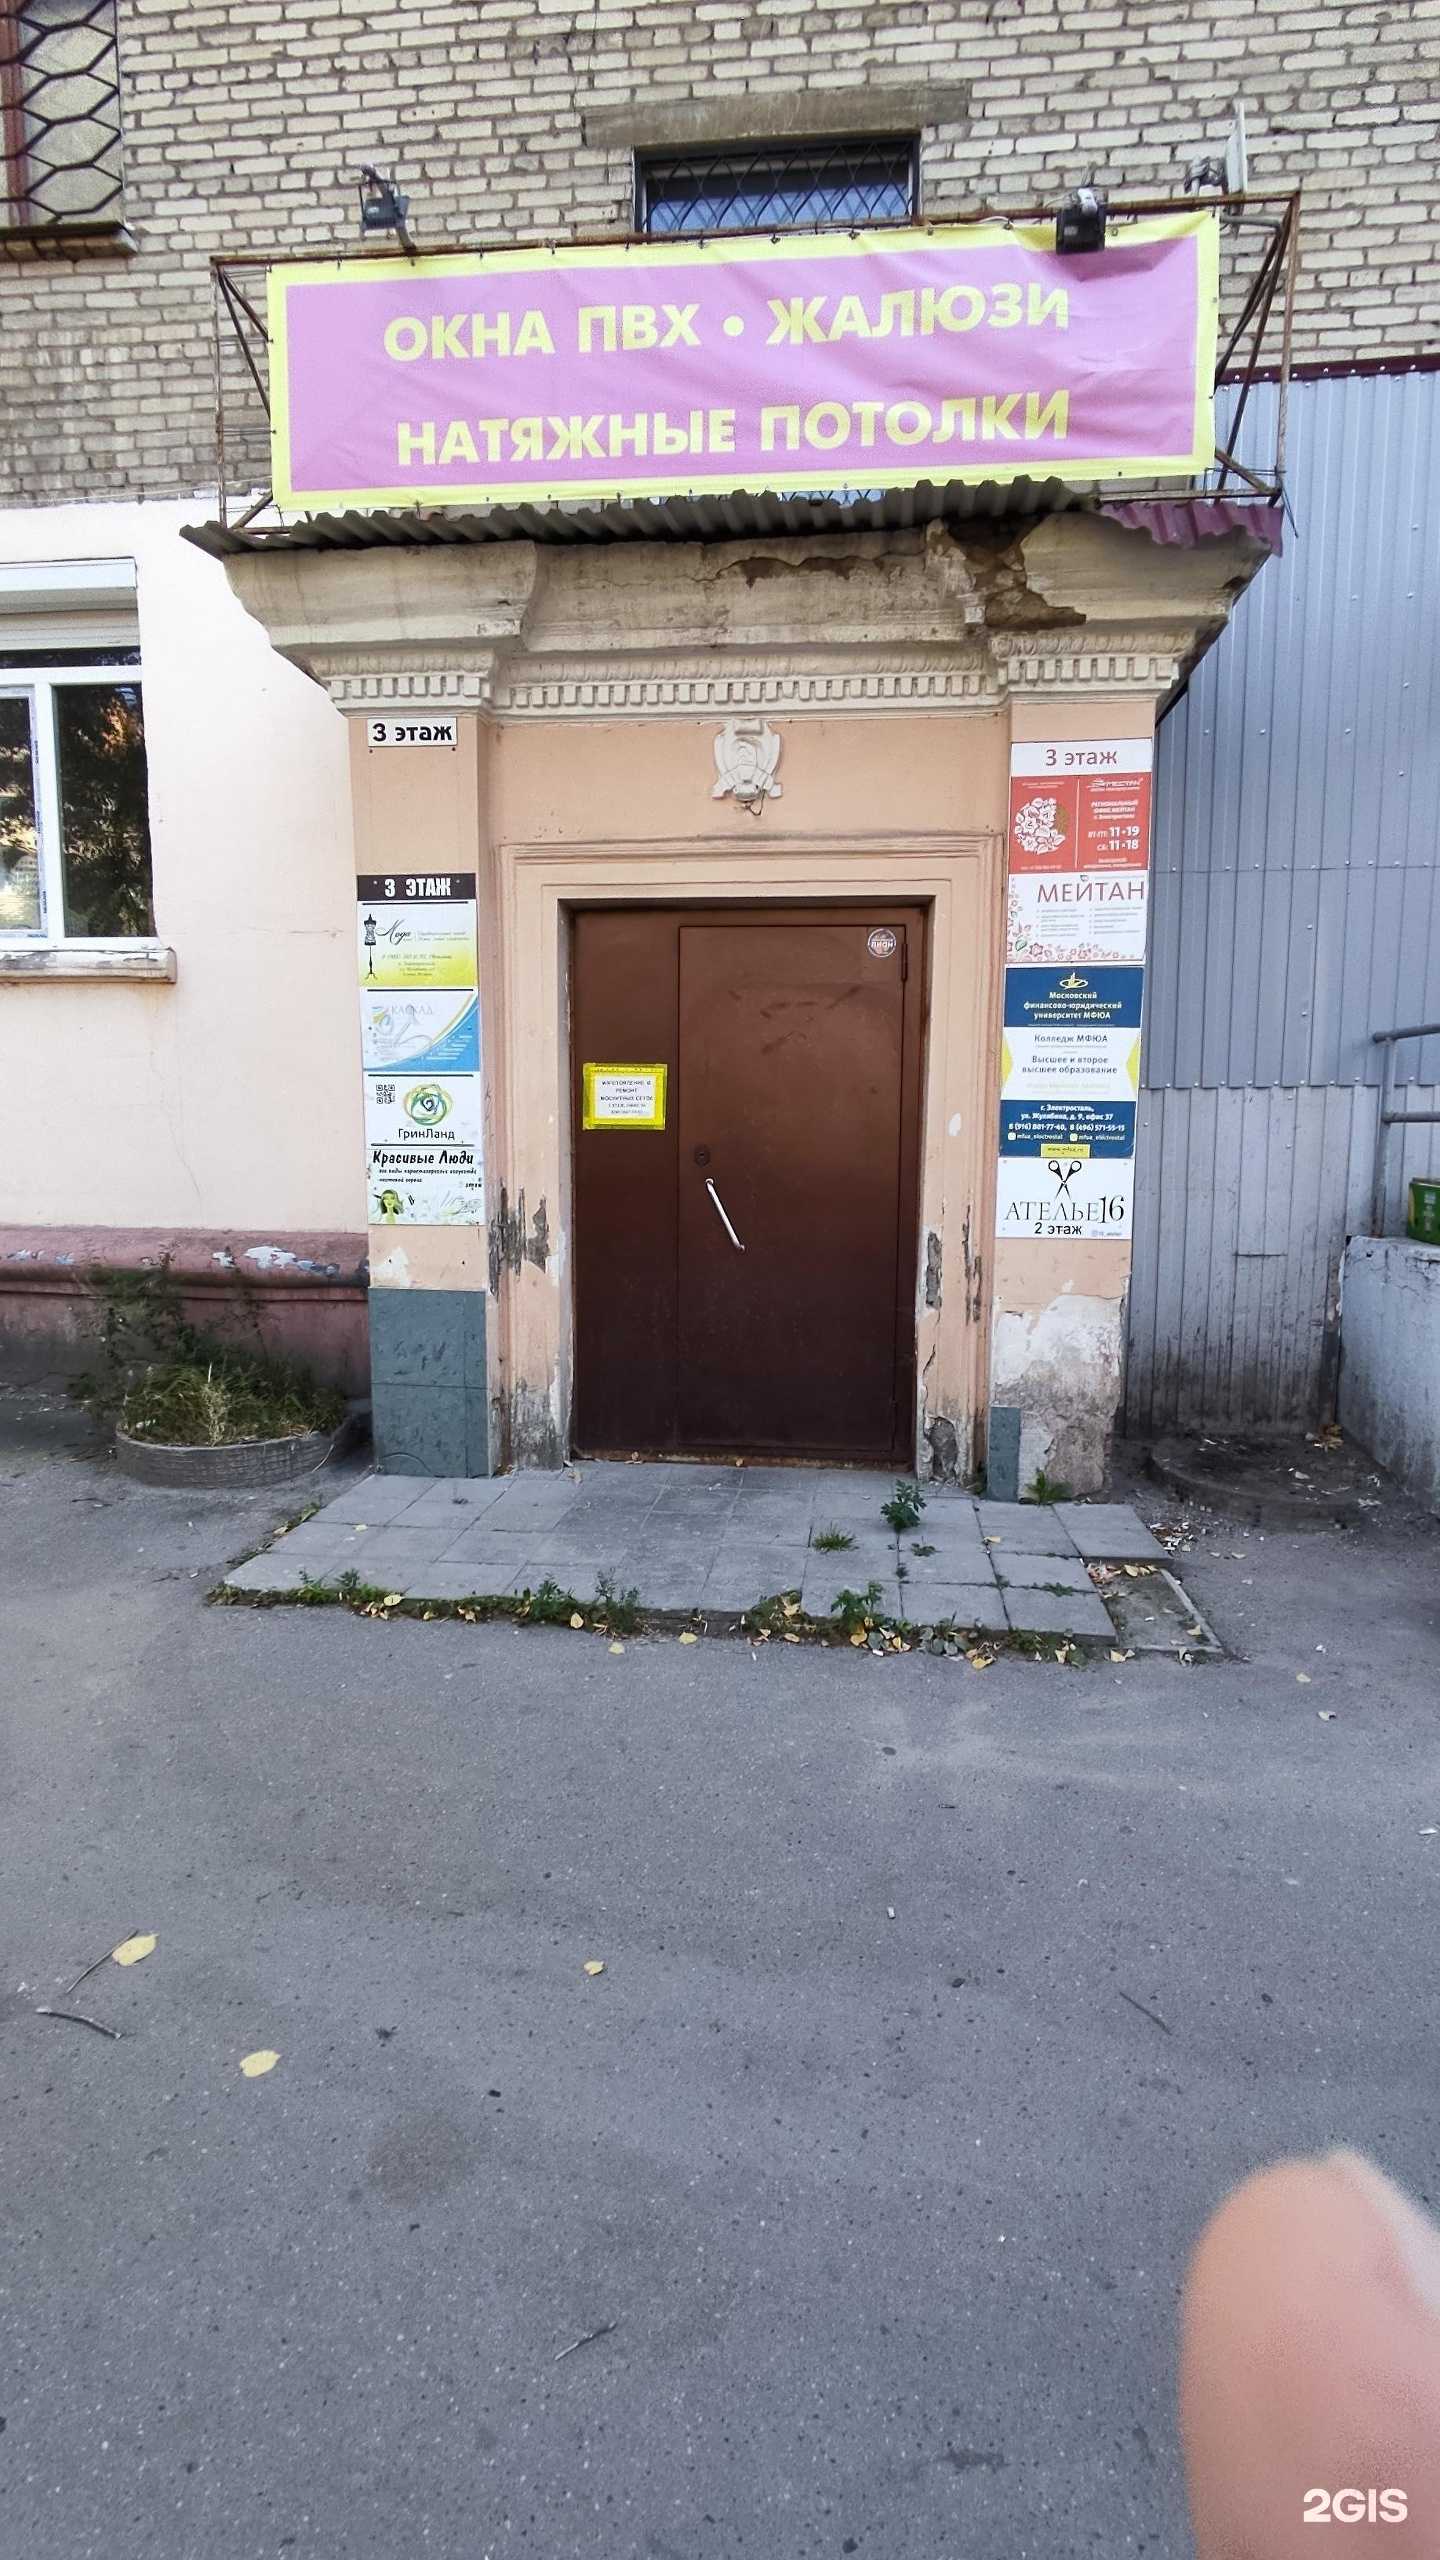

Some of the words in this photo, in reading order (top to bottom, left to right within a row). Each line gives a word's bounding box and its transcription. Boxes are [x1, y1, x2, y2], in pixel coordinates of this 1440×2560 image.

[383, 310, 556, 362] ОКНА
[577, 304, 701, 352] ПВХ
[766, 282, 1069, 345] ЖАЛЮЗИ
[397, 408, 737, 466] НАТЯЖНЫЕ
[760, 390, 1071, 452] ПОТОЛКИ
[372, 723, 387, 742] 3
[395, 726, 453, 742] этаж
[1045, 749, 1057, 766] 3
[1064, 751, 1118, 765] этаж
[384, 878, 396, 897] 3
[405, 877, 452, 897] ЭТАЖ
[1034, 1012, 1081, 1020] университет
[1034, 1034, 1074, 1043] Колледж
[1076, 1034, 1108, 1043] МФЮА
[1032, 1055, 1067, 1064] Высшее
[1079, 1057, 1109, 1065] второе
[1059, 1065, 1118, 1075] образование
[398, 1128, 455, 1140] ГринЛанд
[372, 1149, 434, 1167] Красивые
[439, 1150, 474, 1164] Люди
[1034, 1222, 1042, 1234] 2
[1047, 1225, 1082, 1235] этаж
